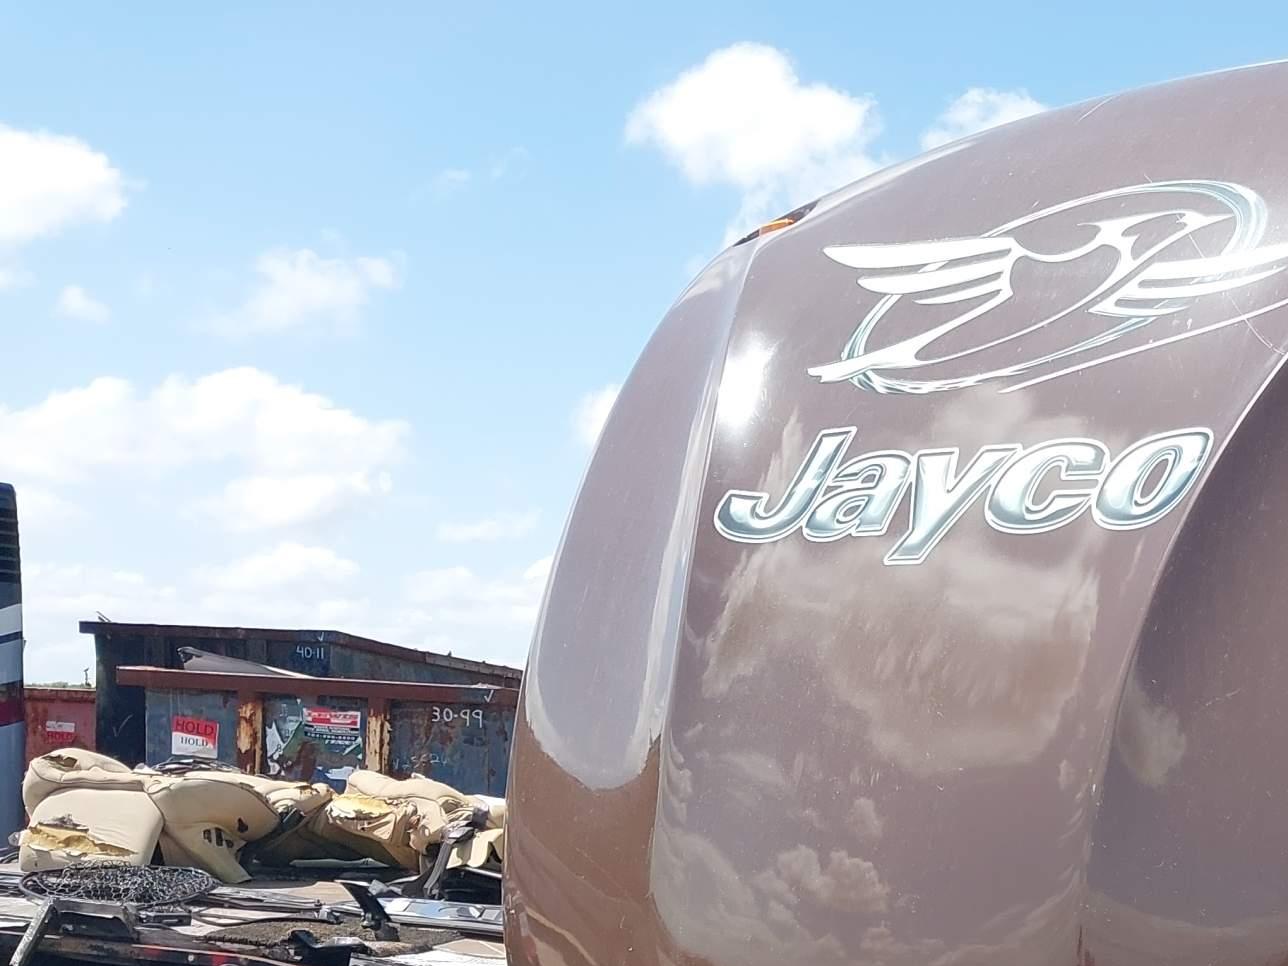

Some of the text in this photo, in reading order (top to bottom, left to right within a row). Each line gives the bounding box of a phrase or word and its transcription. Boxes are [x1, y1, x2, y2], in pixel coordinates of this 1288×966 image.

[713, 426, 1214, 565] Jayco
[431, 706, 483, 728] 30-99
[175, 719, 214, 736] HOLD
[180, 736, 209, 747] HOLD
